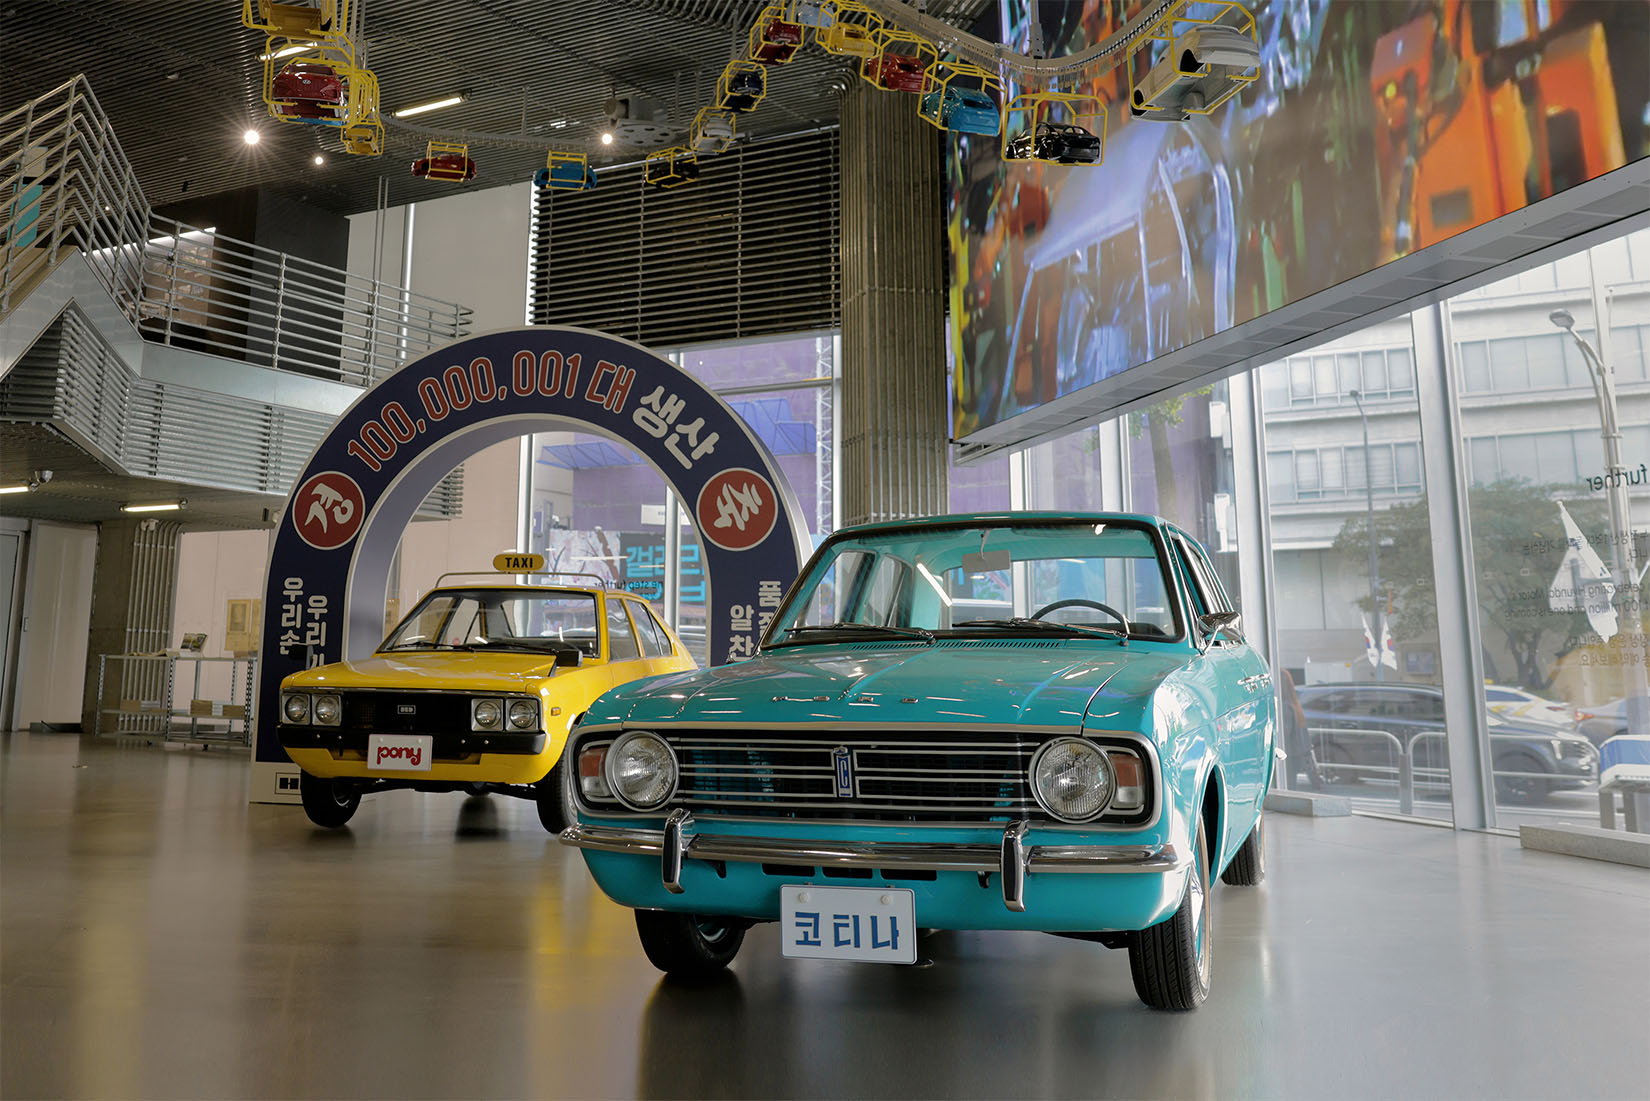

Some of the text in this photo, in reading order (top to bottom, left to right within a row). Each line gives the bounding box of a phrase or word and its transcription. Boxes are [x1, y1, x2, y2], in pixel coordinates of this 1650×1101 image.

[346, 350, 722, 473] 100,000,001 대 생산
[303, 481, 356, 536] 경
[714, 480, 764, 531] 축
[505, 557, 534, 570] TAXI
[376, 745, 422, 767] pony
[794, 911, 901, 951] 코티나
